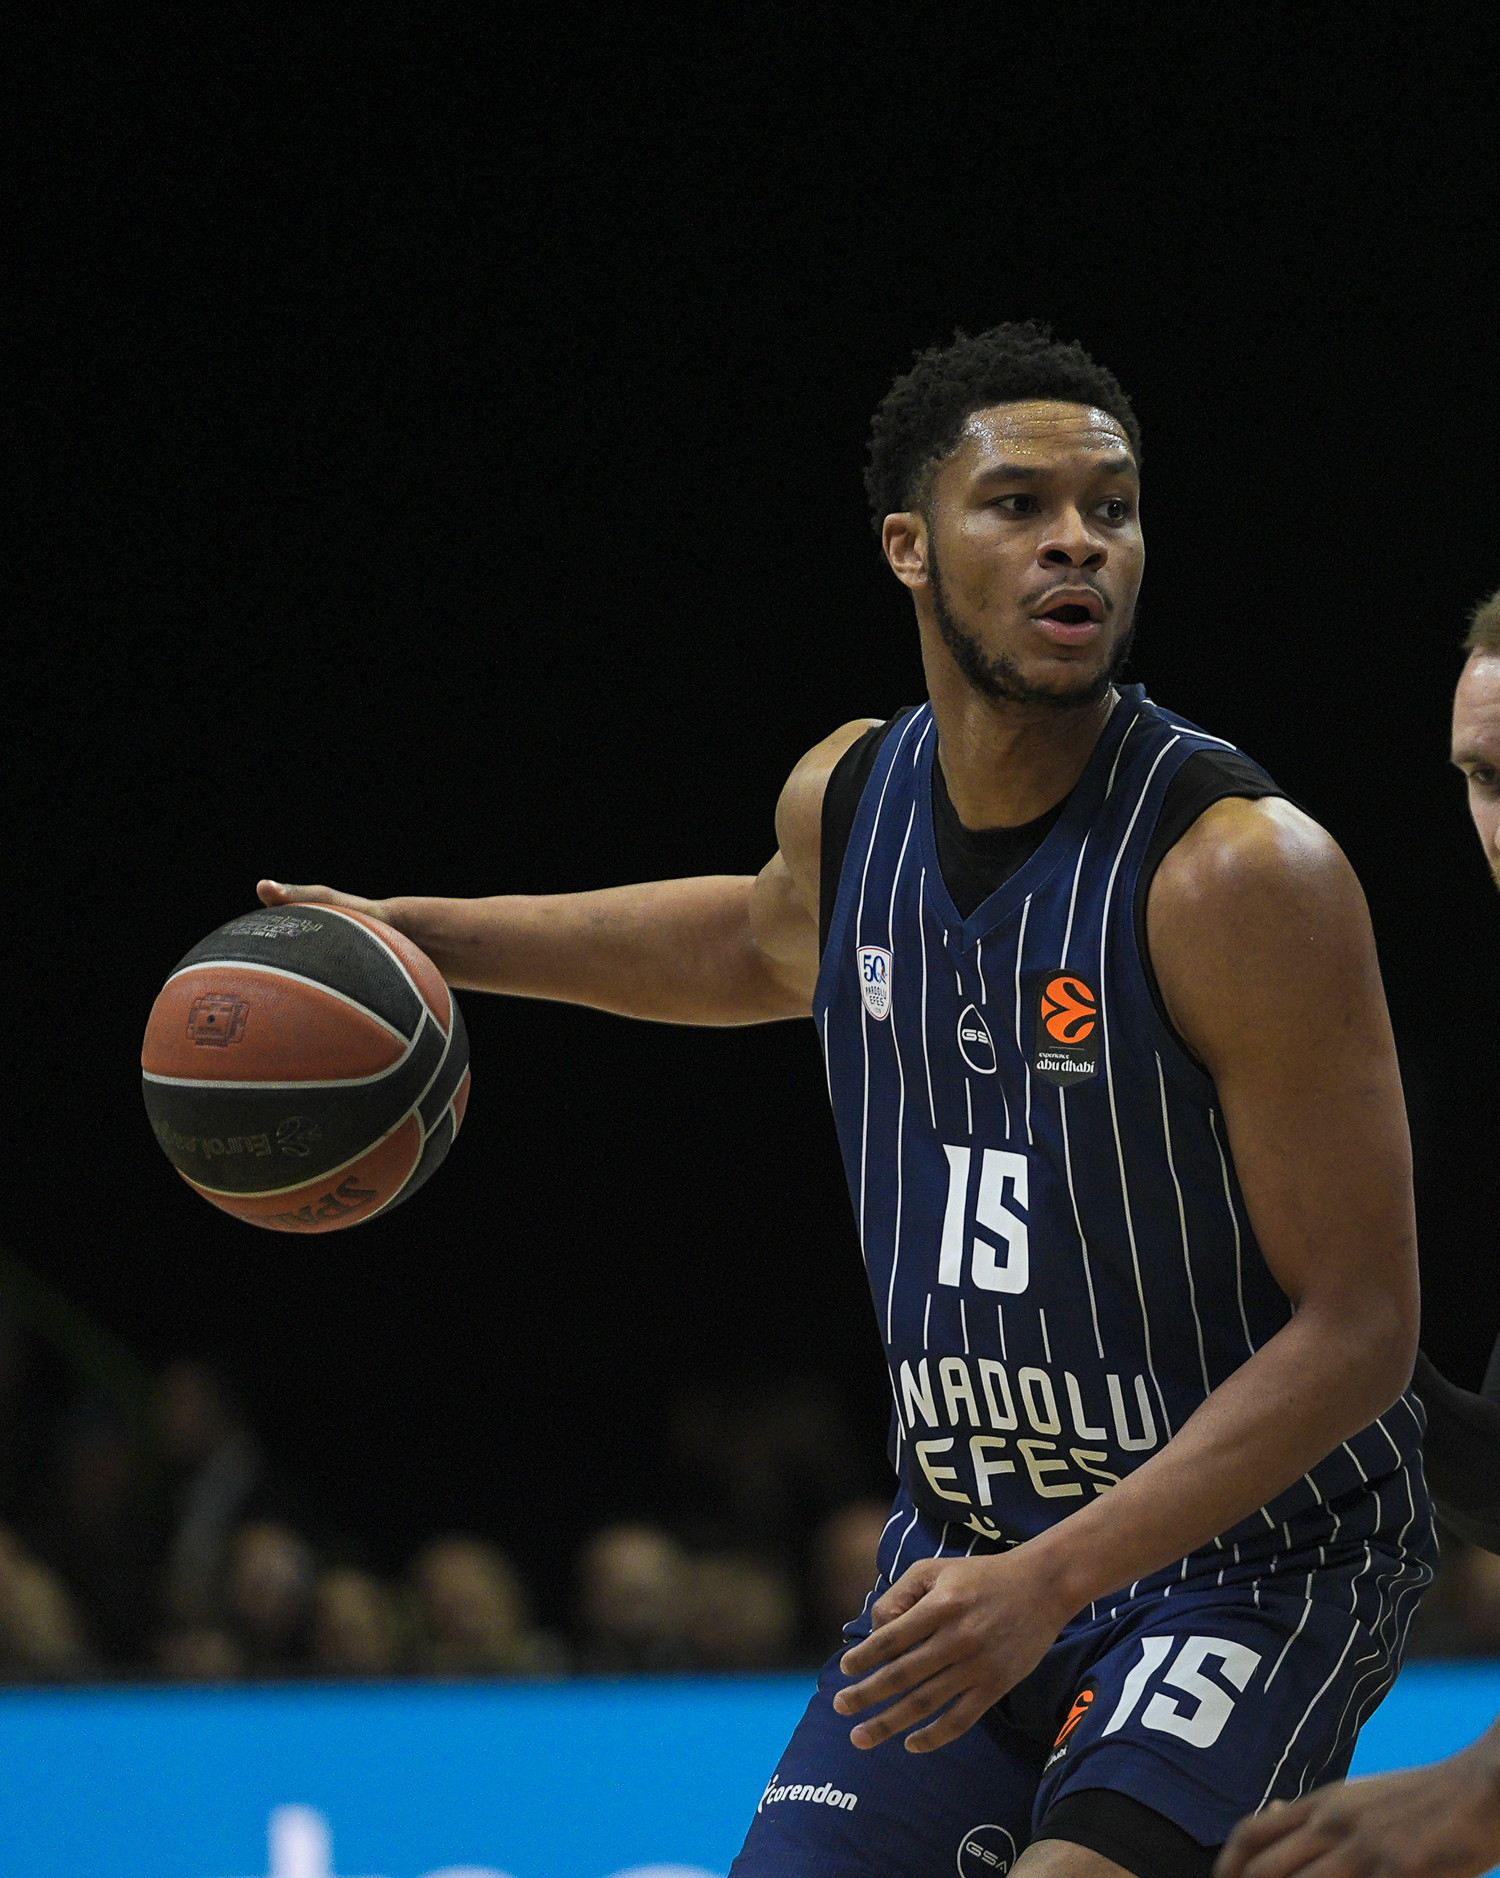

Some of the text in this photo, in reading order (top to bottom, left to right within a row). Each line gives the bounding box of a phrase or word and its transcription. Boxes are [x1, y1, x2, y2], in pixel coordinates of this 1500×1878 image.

[864, 954, 887, 984] 50
[961, 1028, 991, 1046] GS
[1036, 1059, 1095, 1073] abu dhabi
[938, 1143, 1030, 1294] 15
[900, 1357, 1158, 1451] NADOLU
[1101, 1635, 1262, 1749] 15
[766, 1782, 858, 1811] corendon
[965, 1841, 1007, 1875] GSA
